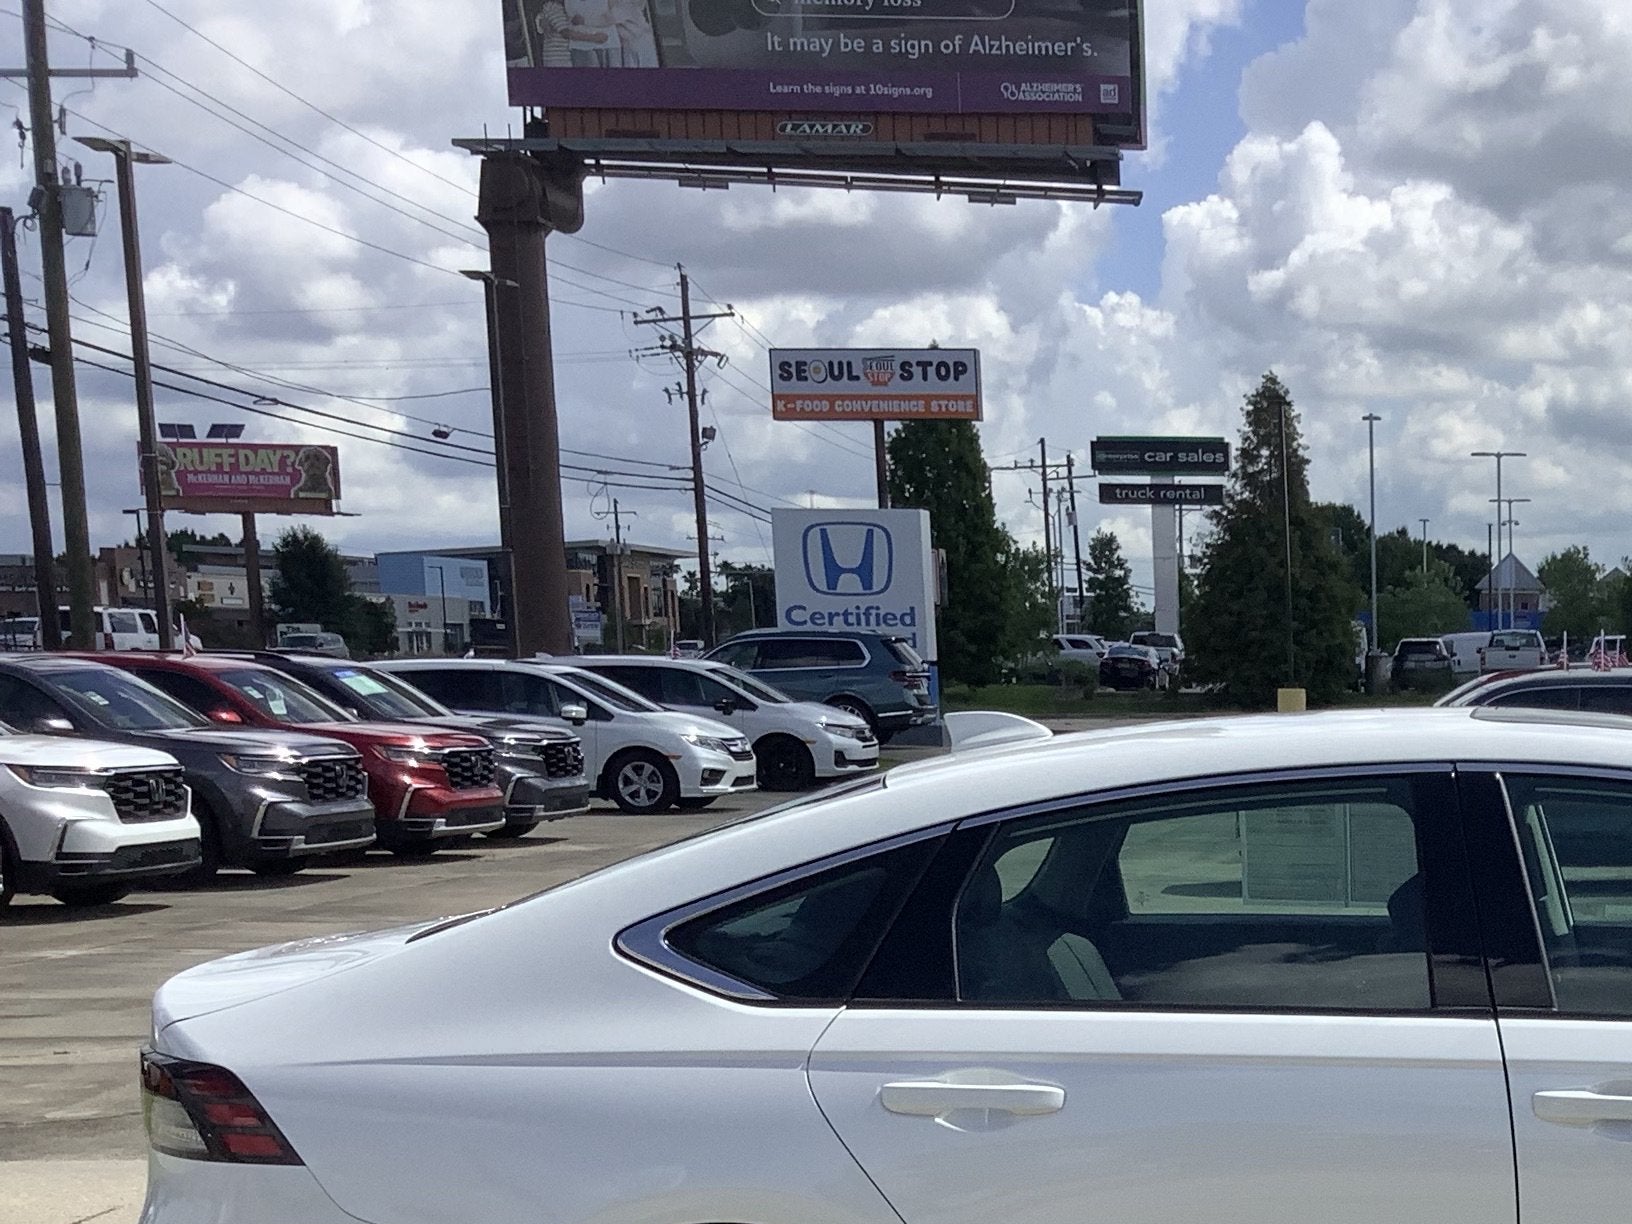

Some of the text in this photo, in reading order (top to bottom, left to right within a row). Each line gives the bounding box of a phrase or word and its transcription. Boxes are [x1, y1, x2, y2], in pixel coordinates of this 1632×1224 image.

[766, 31, 1099, 59] It may be a sign of Alzheimer's.
[769, 81, 933, 98] Learn the signs at 10signs.org
[1018, 91, 1082, 101] ASSOCIATION
[784, 122, 864, 135] LAMAR
[778, 359, 968, 384] SEOUL STOP
[776, 400, 974, 413] K-FOOD CONVENIENCE STORE
[175, 447, 297, 473] RUFF DAY?
[1144, 451, 1174, 462] car
[1177, 448, 1225, 463] sales
[1115, 486, 1205, 500] truck rental
[785, 604, 917, 627] Certified
